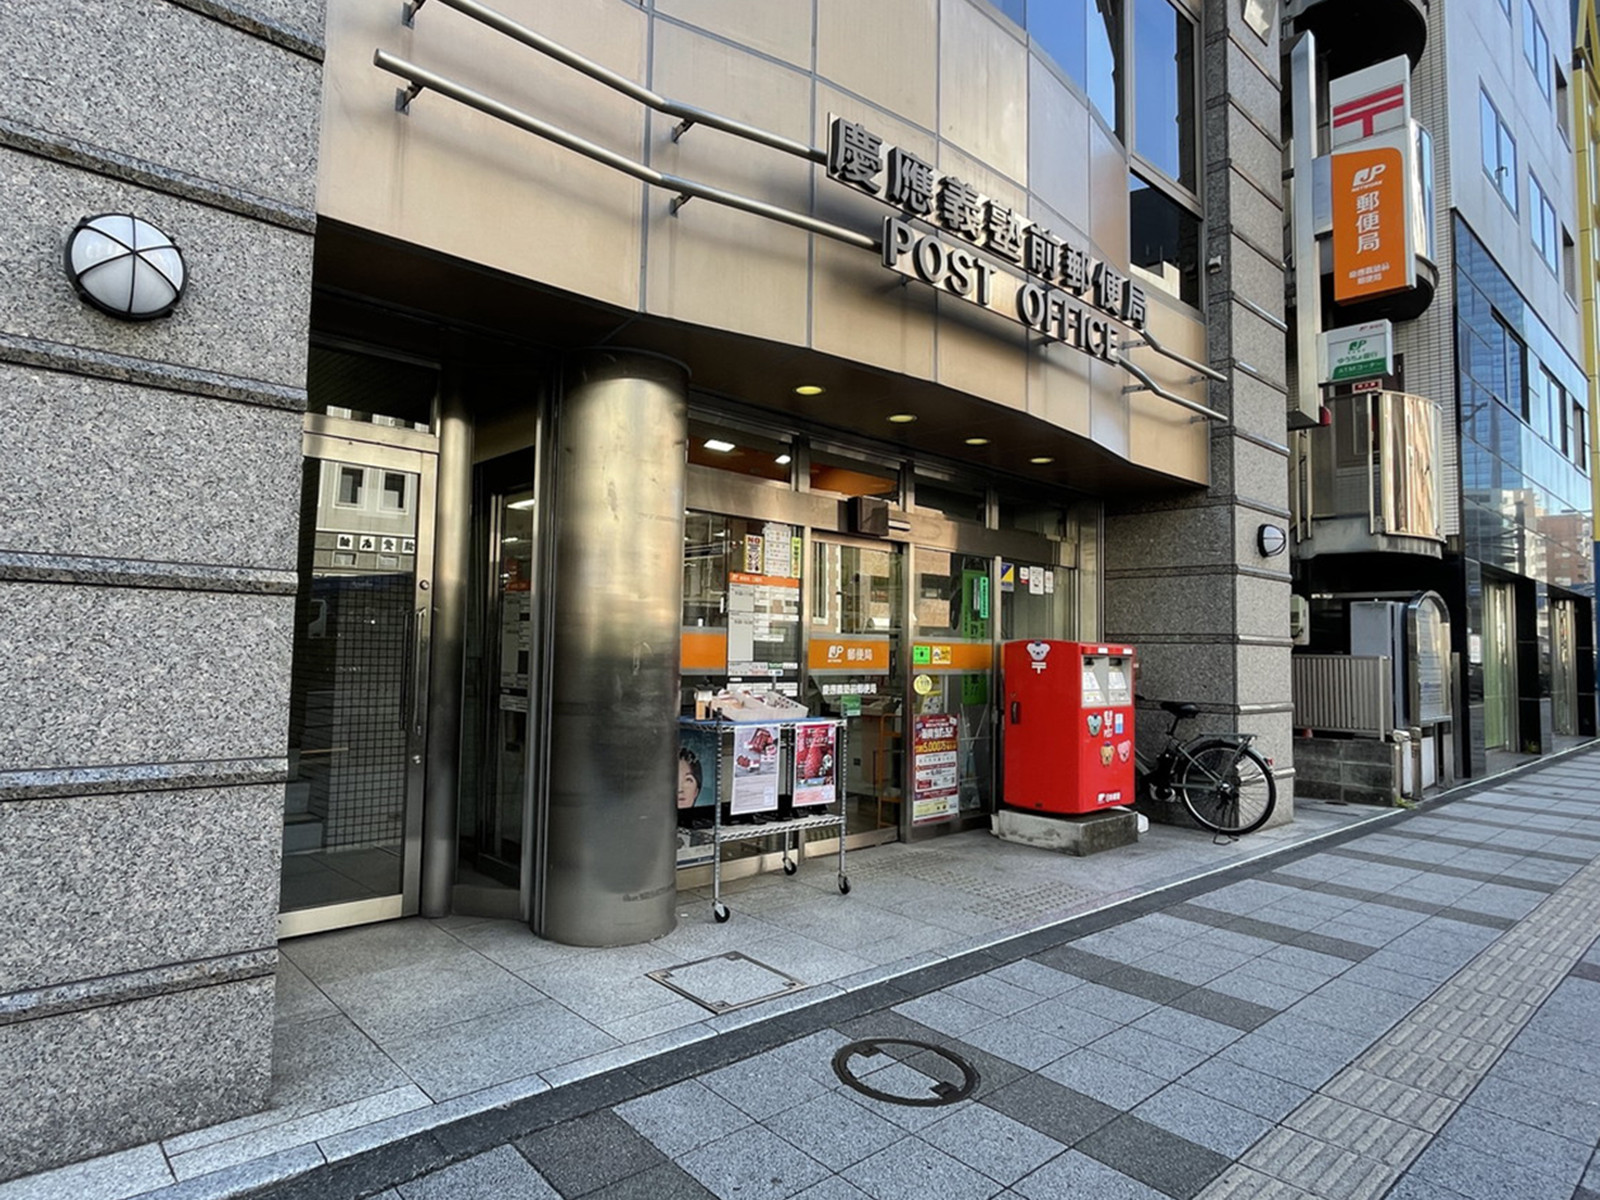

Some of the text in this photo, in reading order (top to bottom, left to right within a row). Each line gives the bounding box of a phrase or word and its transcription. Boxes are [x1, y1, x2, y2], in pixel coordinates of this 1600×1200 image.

[829, 115, 1148, 330] 慶應義塾前郵便局
[1355, 190, 1380, 255] 郵便局
[883, 216, 1121, 365] POST OFFICE
[847, 647, 873, 661] 郵便局
